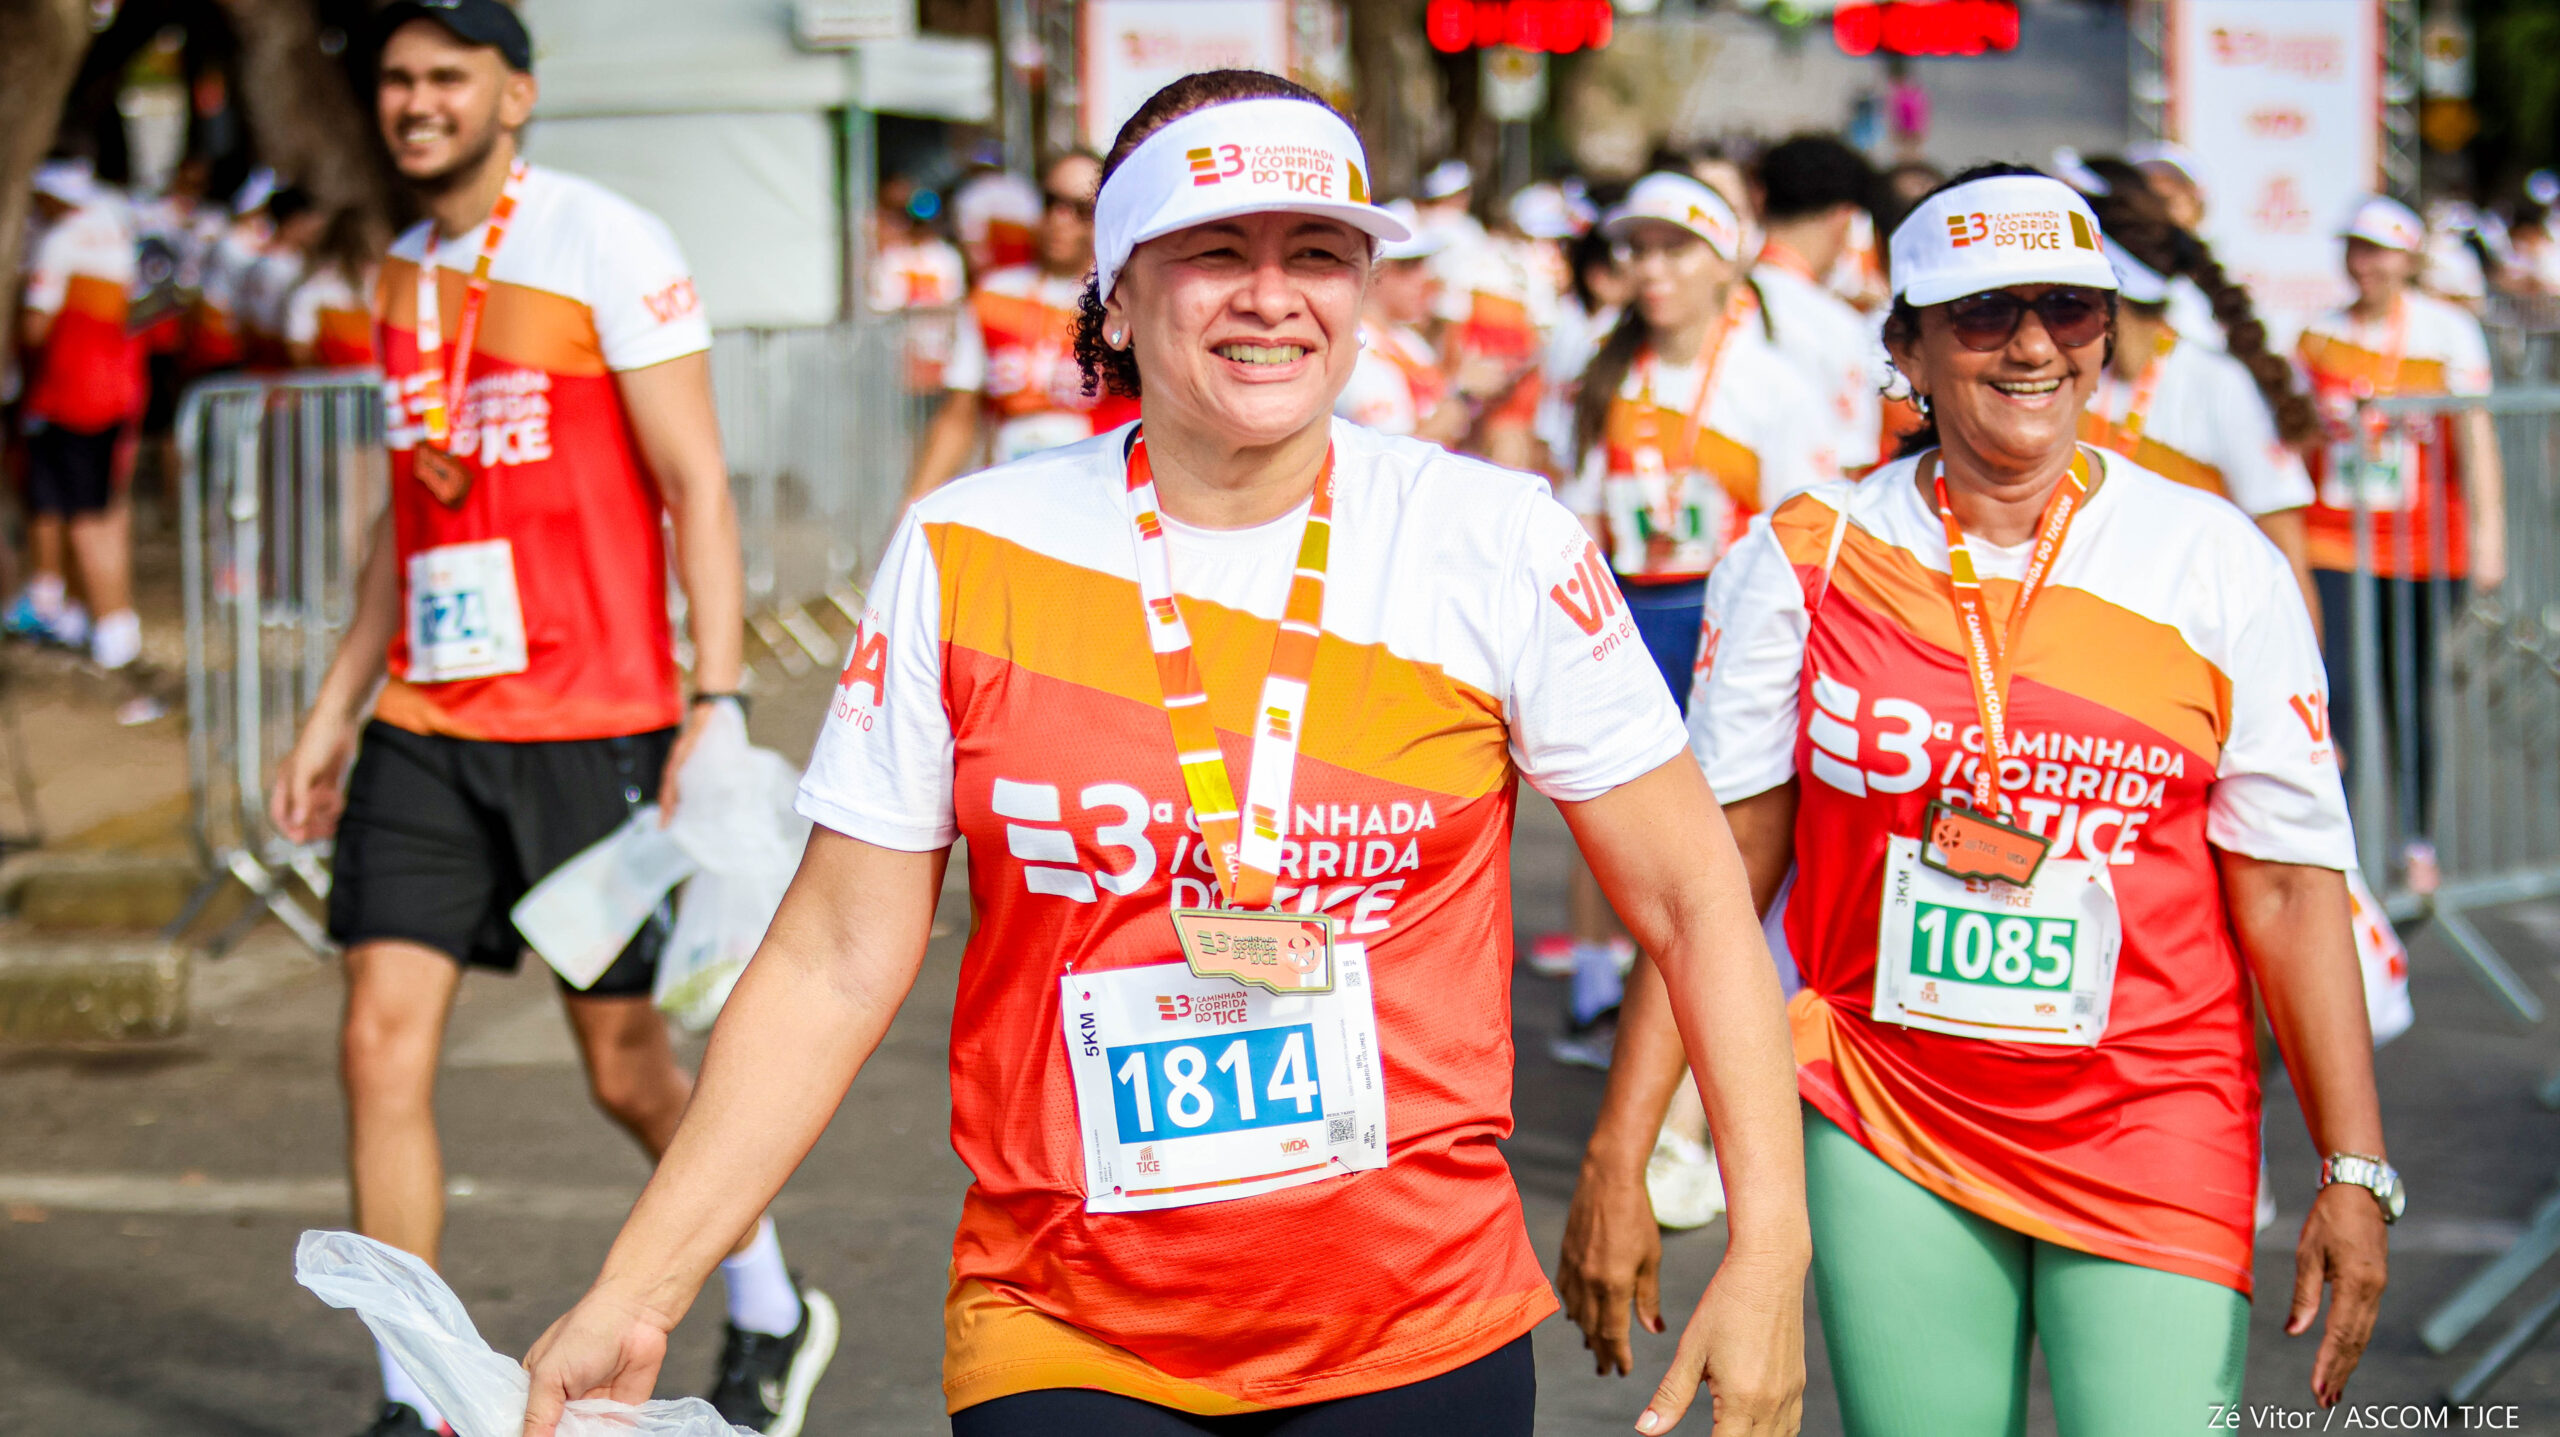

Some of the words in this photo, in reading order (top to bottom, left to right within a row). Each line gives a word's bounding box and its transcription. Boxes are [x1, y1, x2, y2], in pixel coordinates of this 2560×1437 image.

[1255, 145, 1335, 162] CAMINHADA
[1252, 169, 1280, 184] DO
[1283, 170, 1332, 198] TJCE
[1994, 233, 2016, 246] DO
[2019, 233, 2060, 250] TJCE
[2037, 540, 2054, 562] DO
[1960, 724, 2184, 780] CMINHADA
[1976, 771, 1992, 806] 2026
[2019, 798, 2150, 867] TJCE
[1169, 834, 1420, 881] /CRRIDA
[1895, 869, 1911, 908] 3KM
[1247, 951, 1279, 966] TJCE
[1916, 907, 2073, 987] 1085
[1196, 991, 1248, 1003] CAMINHADA
[1194, 1012, 1212, 1023] DO
[1213, 1008, 1247, 1025] TJCE
[1079, 1012, 1100, 1057] 5KM
[1116, 1031, 1319, 1134] 1814
[1280, 1139, 1309, 1153] VIDA
[1136, 1160, 1161, 1174] TJCE
